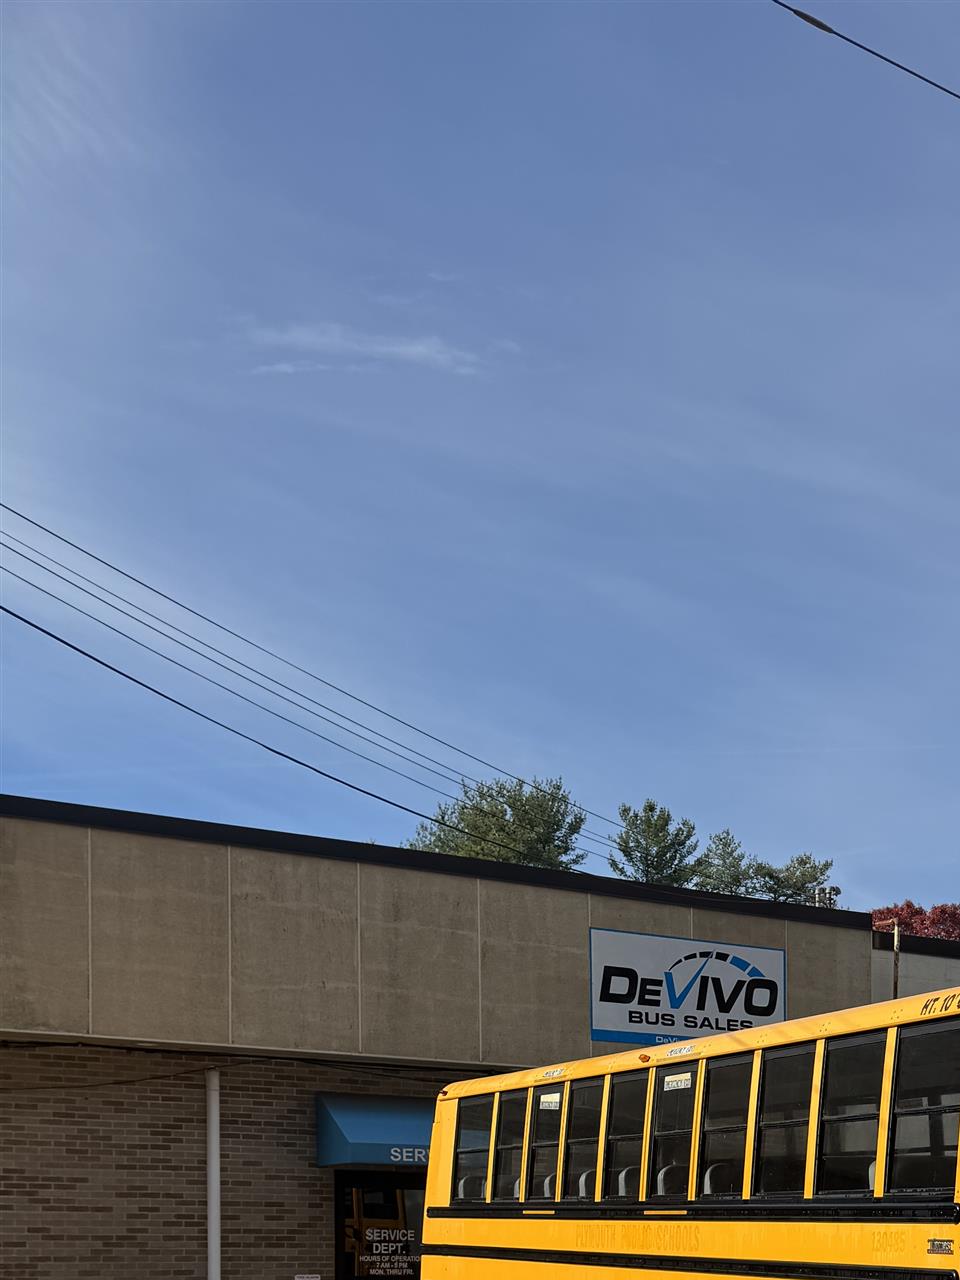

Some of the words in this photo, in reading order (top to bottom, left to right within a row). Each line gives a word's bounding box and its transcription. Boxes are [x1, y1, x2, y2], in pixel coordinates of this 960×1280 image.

[628, 1010, 676, 1027] BUS
[683, 1015, 753, 1032] SALES
[390, 1147, 430, 1162] SER
[365, 1229, 415, 1241] SERVICE
[372, 1243, 406, 1254] DEPT.
